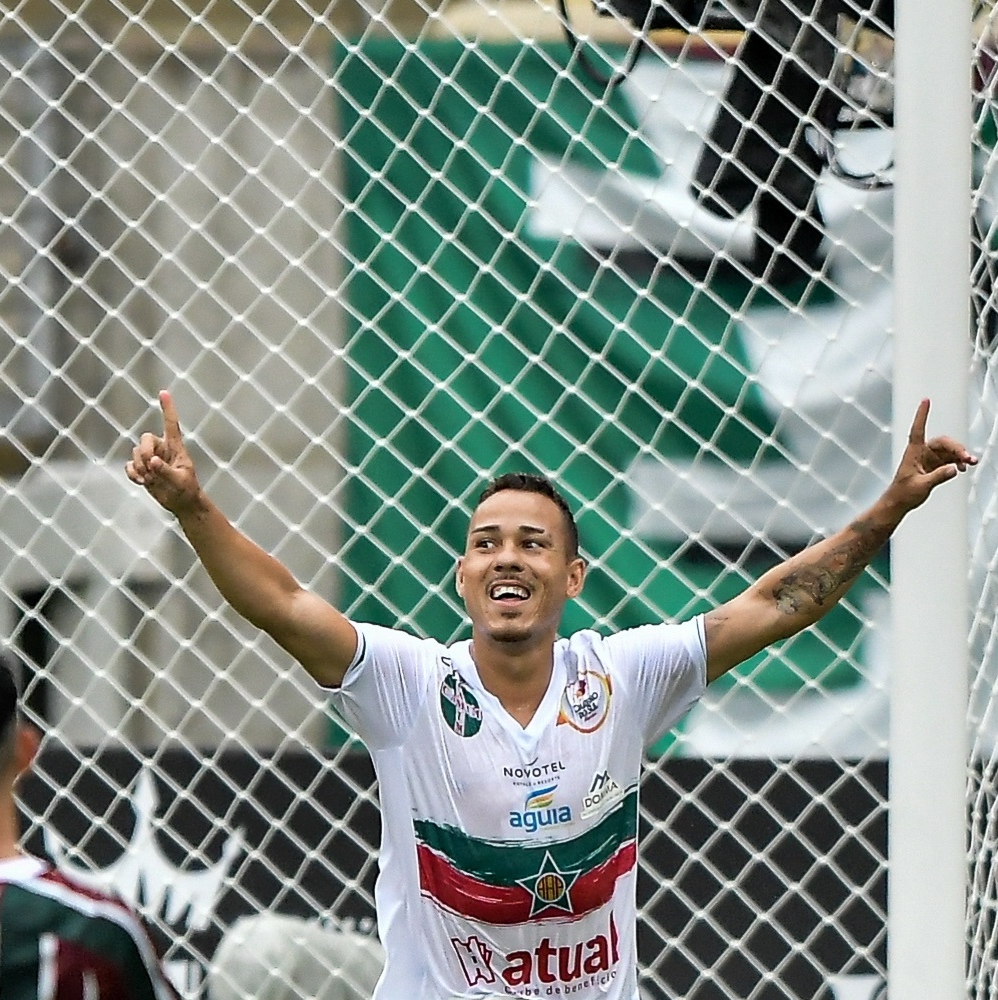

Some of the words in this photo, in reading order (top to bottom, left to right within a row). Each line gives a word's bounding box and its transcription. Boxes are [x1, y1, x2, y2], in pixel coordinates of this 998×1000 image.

[503, 760, 566, 779] NOVOTEL
[502, 909, 620, 987] atual
[546, 985, 561, 995] de
